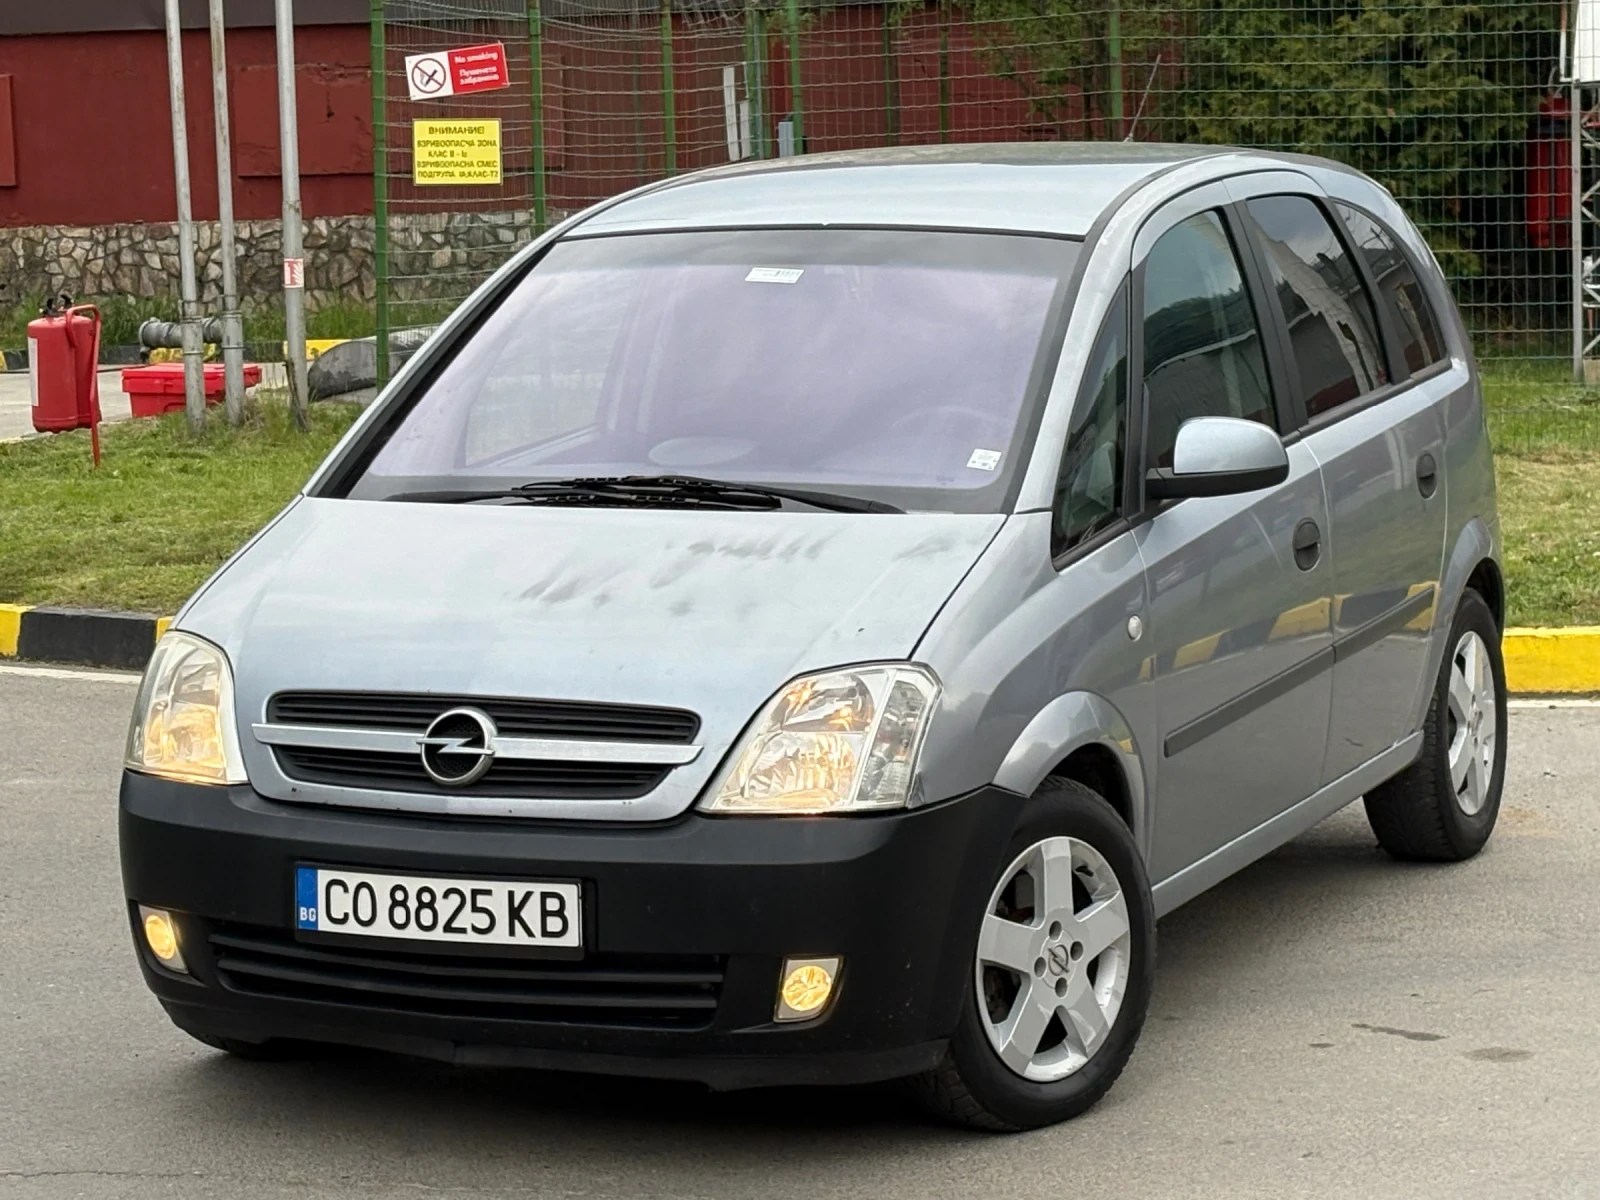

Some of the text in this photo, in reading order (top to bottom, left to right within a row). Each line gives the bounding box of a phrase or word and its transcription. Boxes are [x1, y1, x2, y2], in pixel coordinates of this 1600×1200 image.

[467, 52, 498, 62] smoking
[477, 139, 497, 148] ЗОНА
[428, 150, 448, 158] КЛАС
[476, 160, 498, 168] СМЕС
[325, 879, 569, 939] CO 8825 KB
[300, 907, 317, 922] BG
